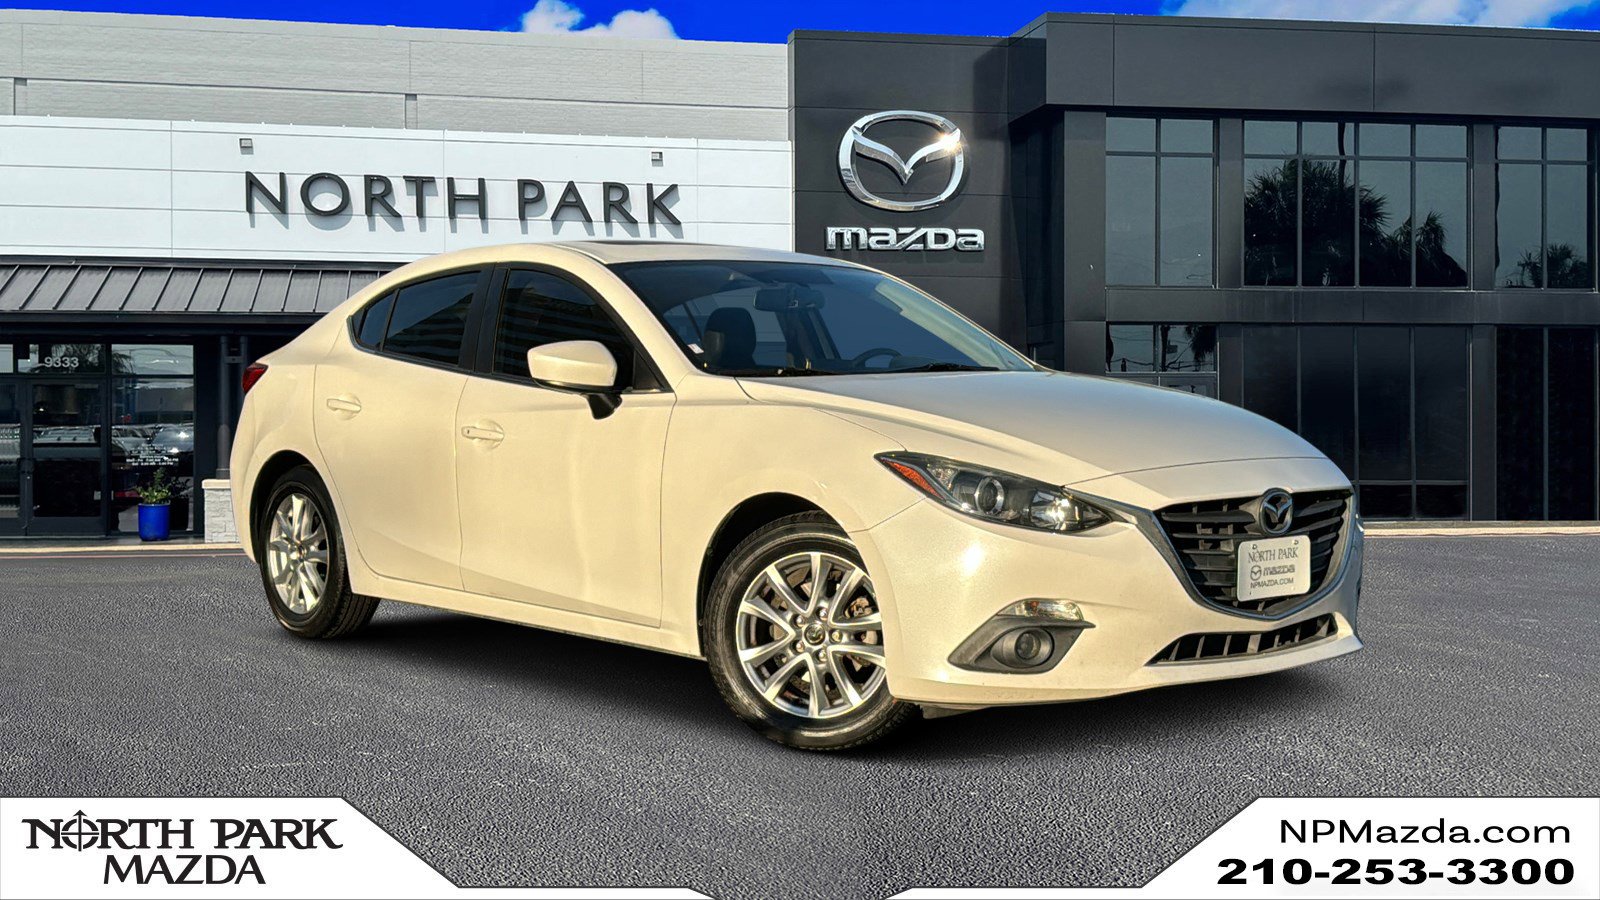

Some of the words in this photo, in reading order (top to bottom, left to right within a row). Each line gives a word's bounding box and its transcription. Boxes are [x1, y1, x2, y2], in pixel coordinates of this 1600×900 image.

[245, 171, 486, 220] NORTH
[517, 179, 680, 225] PARK
[44, 356, 79, 368] 9333
[1248, 548, 1276, 563] NORTH
[1278, 547, 1299, 560] PARK
[1250, 577, 1294, 589] NPMAZDA.COM
